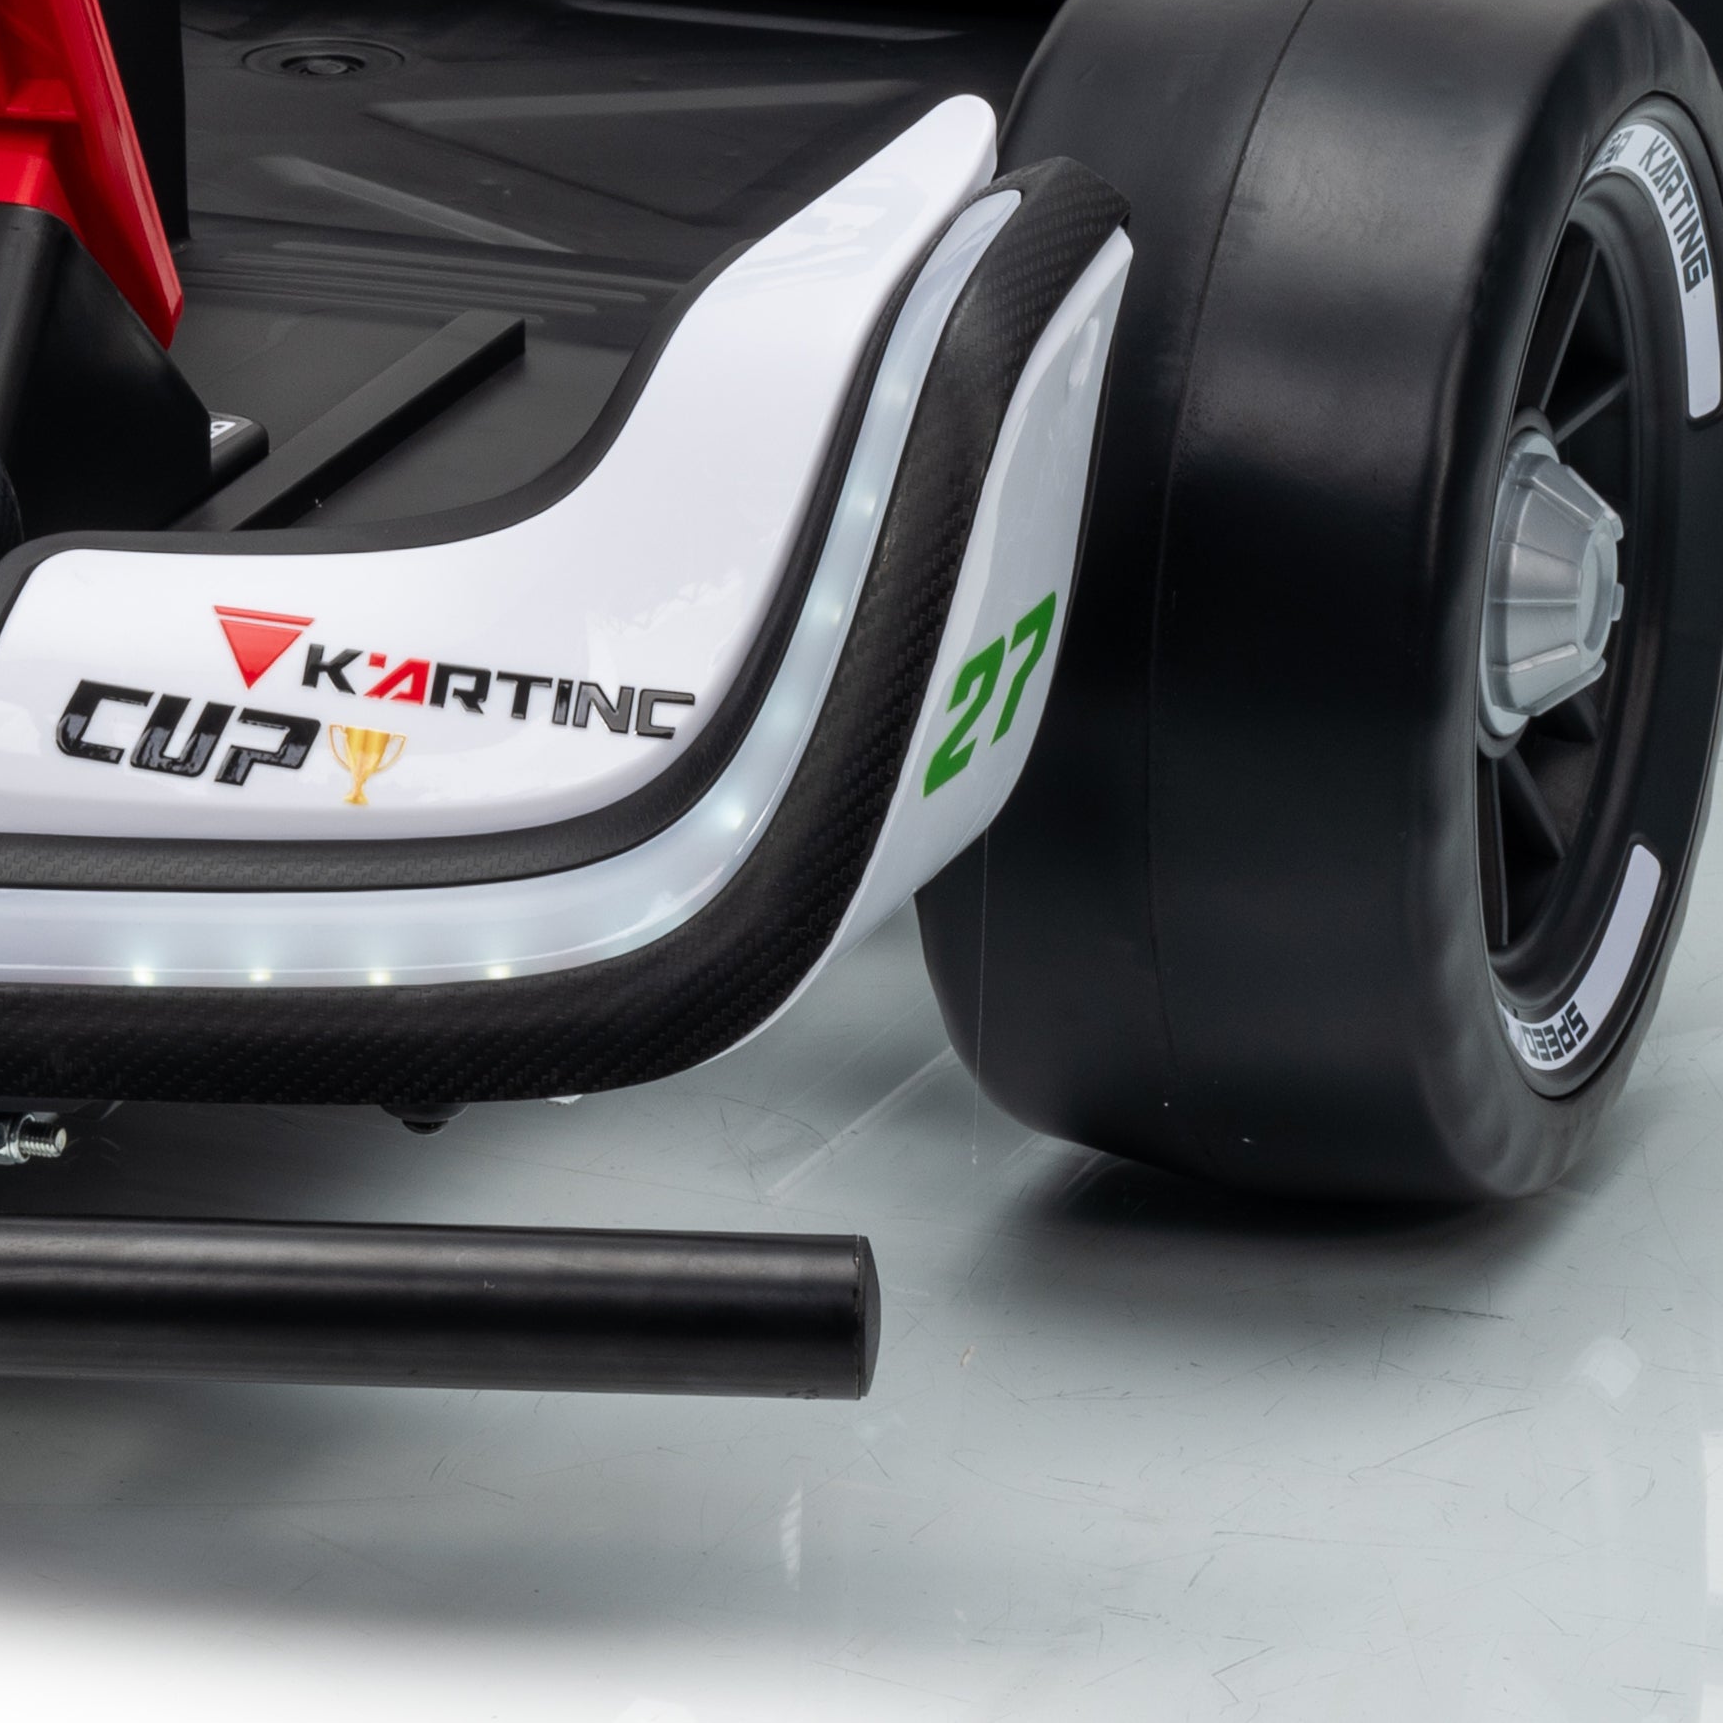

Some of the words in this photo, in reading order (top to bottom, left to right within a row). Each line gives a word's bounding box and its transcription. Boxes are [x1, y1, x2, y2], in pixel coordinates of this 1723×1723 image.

[53, 678, 322, 787] CUP
[921, 589, 1057, 799] 27
[1520, 1000, 1589, 1062] SPEED
